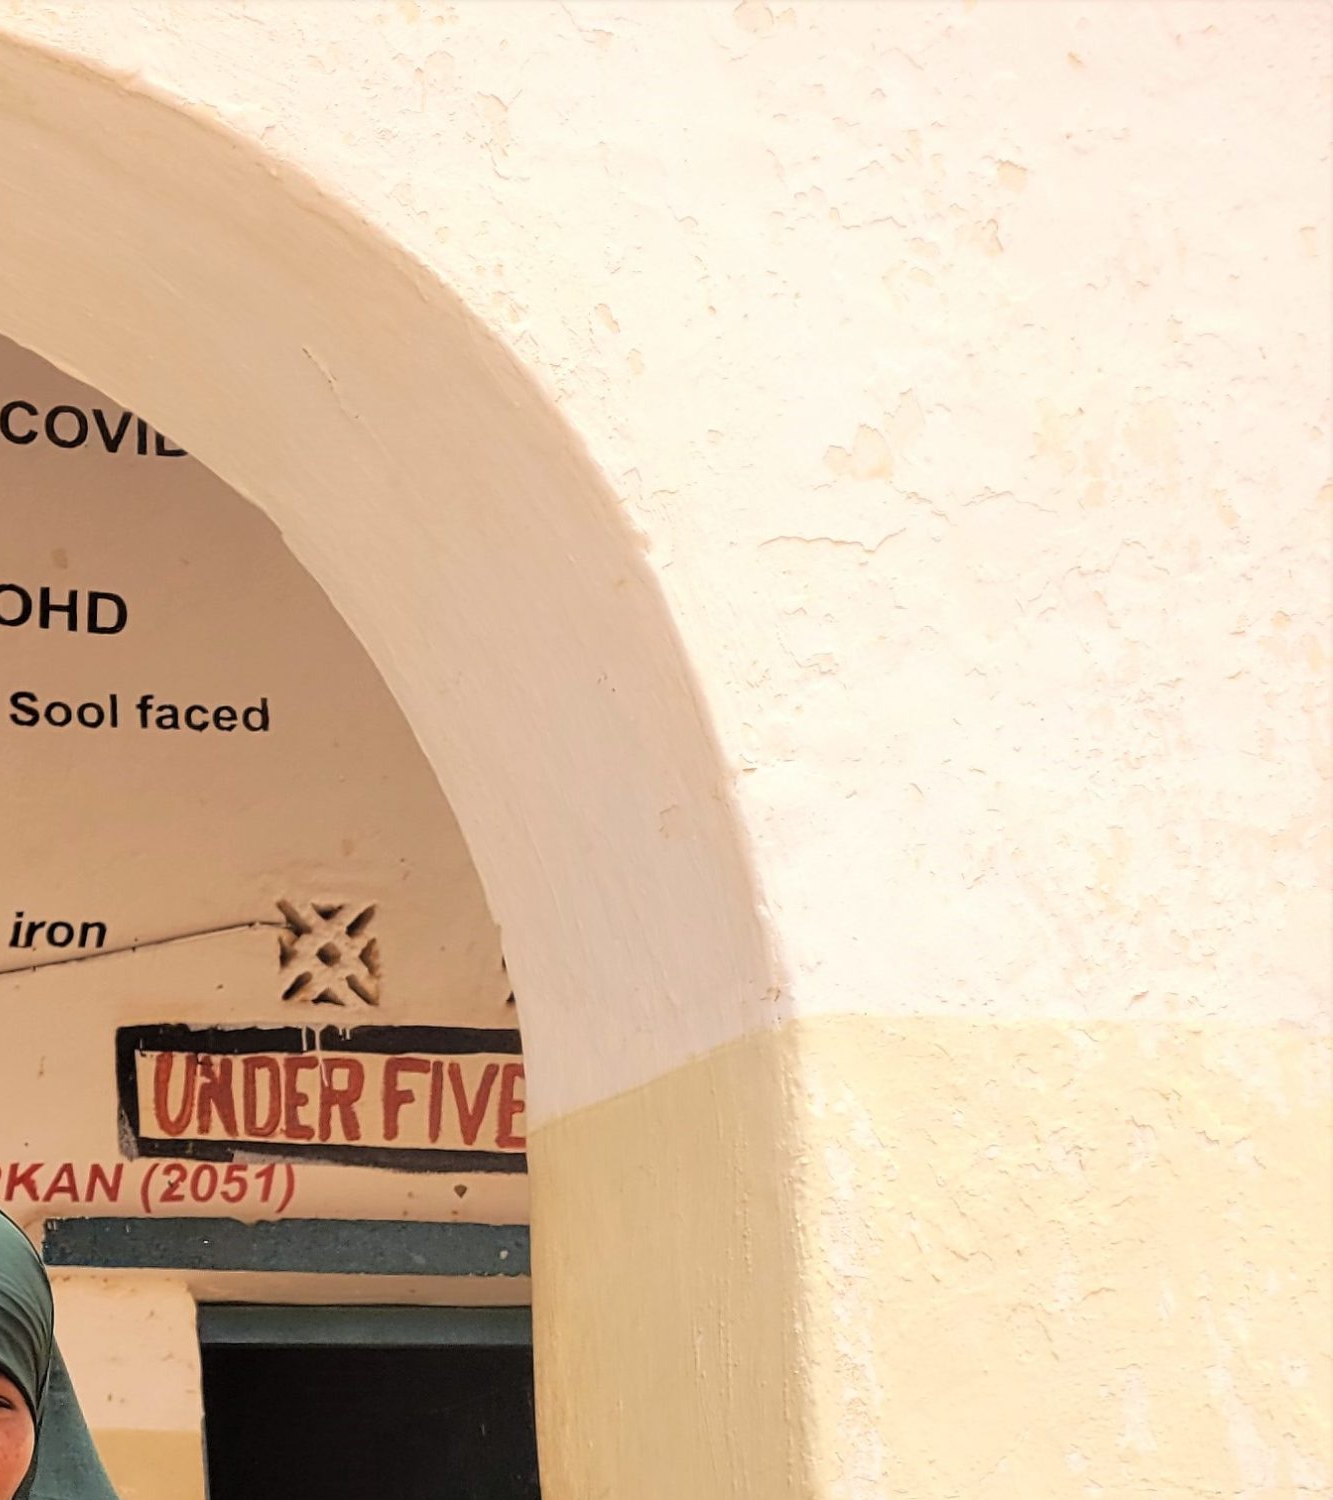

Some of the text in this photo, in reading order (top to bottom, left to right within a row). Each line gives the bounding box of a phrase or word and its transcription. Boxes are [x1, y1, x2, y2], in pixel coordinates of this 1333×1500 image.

[9, 691, 120, 730] Sool
[137, 695, 271, 733] faced
[9, 912, 107, 949] iron
[153, 1052, 526, 1149] UNDER FIVE
[140, 1163, 295, 1213] (2051)
